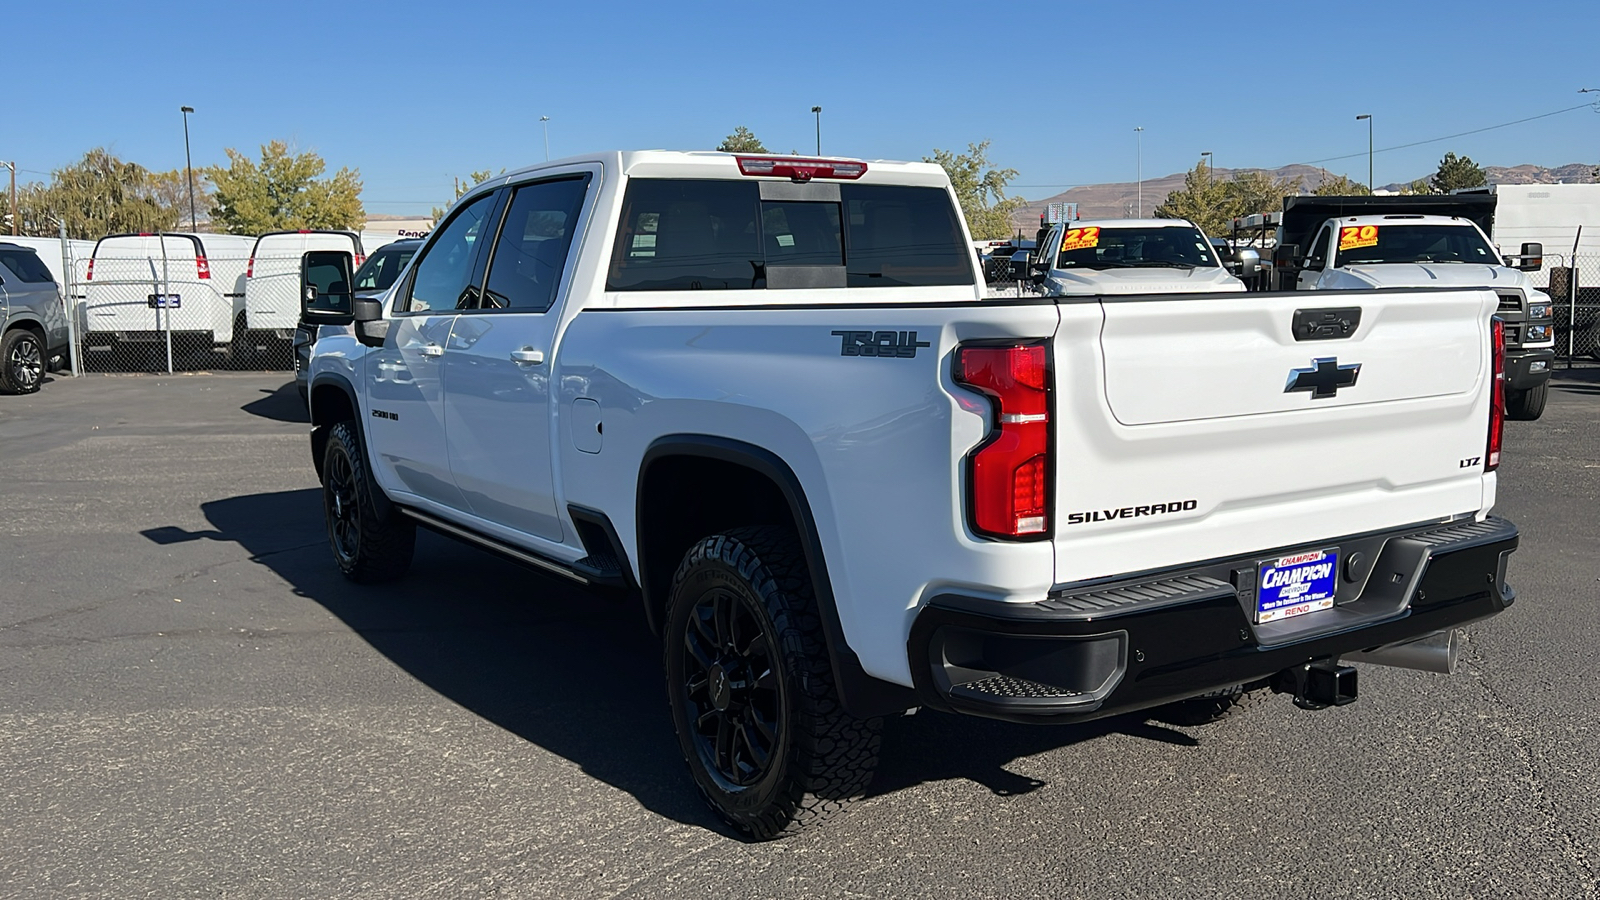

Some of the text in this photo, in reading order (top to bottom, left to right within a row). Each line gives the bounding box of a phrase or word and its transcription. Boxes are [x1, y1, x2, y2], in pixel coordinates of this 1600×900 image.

[1065, 227, 1097, 242] 22
[1342, 226, 1376, 240] 20
[831, 331, 930, 347] TRAIL
[841, 345, 916, 358] BOSS
[1460, 457, 1480, 468] LTZ
[1067, 500, 1197, 524] SILVERADO
[1281, 553, 1320, 566] CHAMPION
[1262, 562, 1332, 589] CHAMPION
[1281, 585, 1309, 595] CHEVROLET
[1285, 605, 1309, 616] RENO
